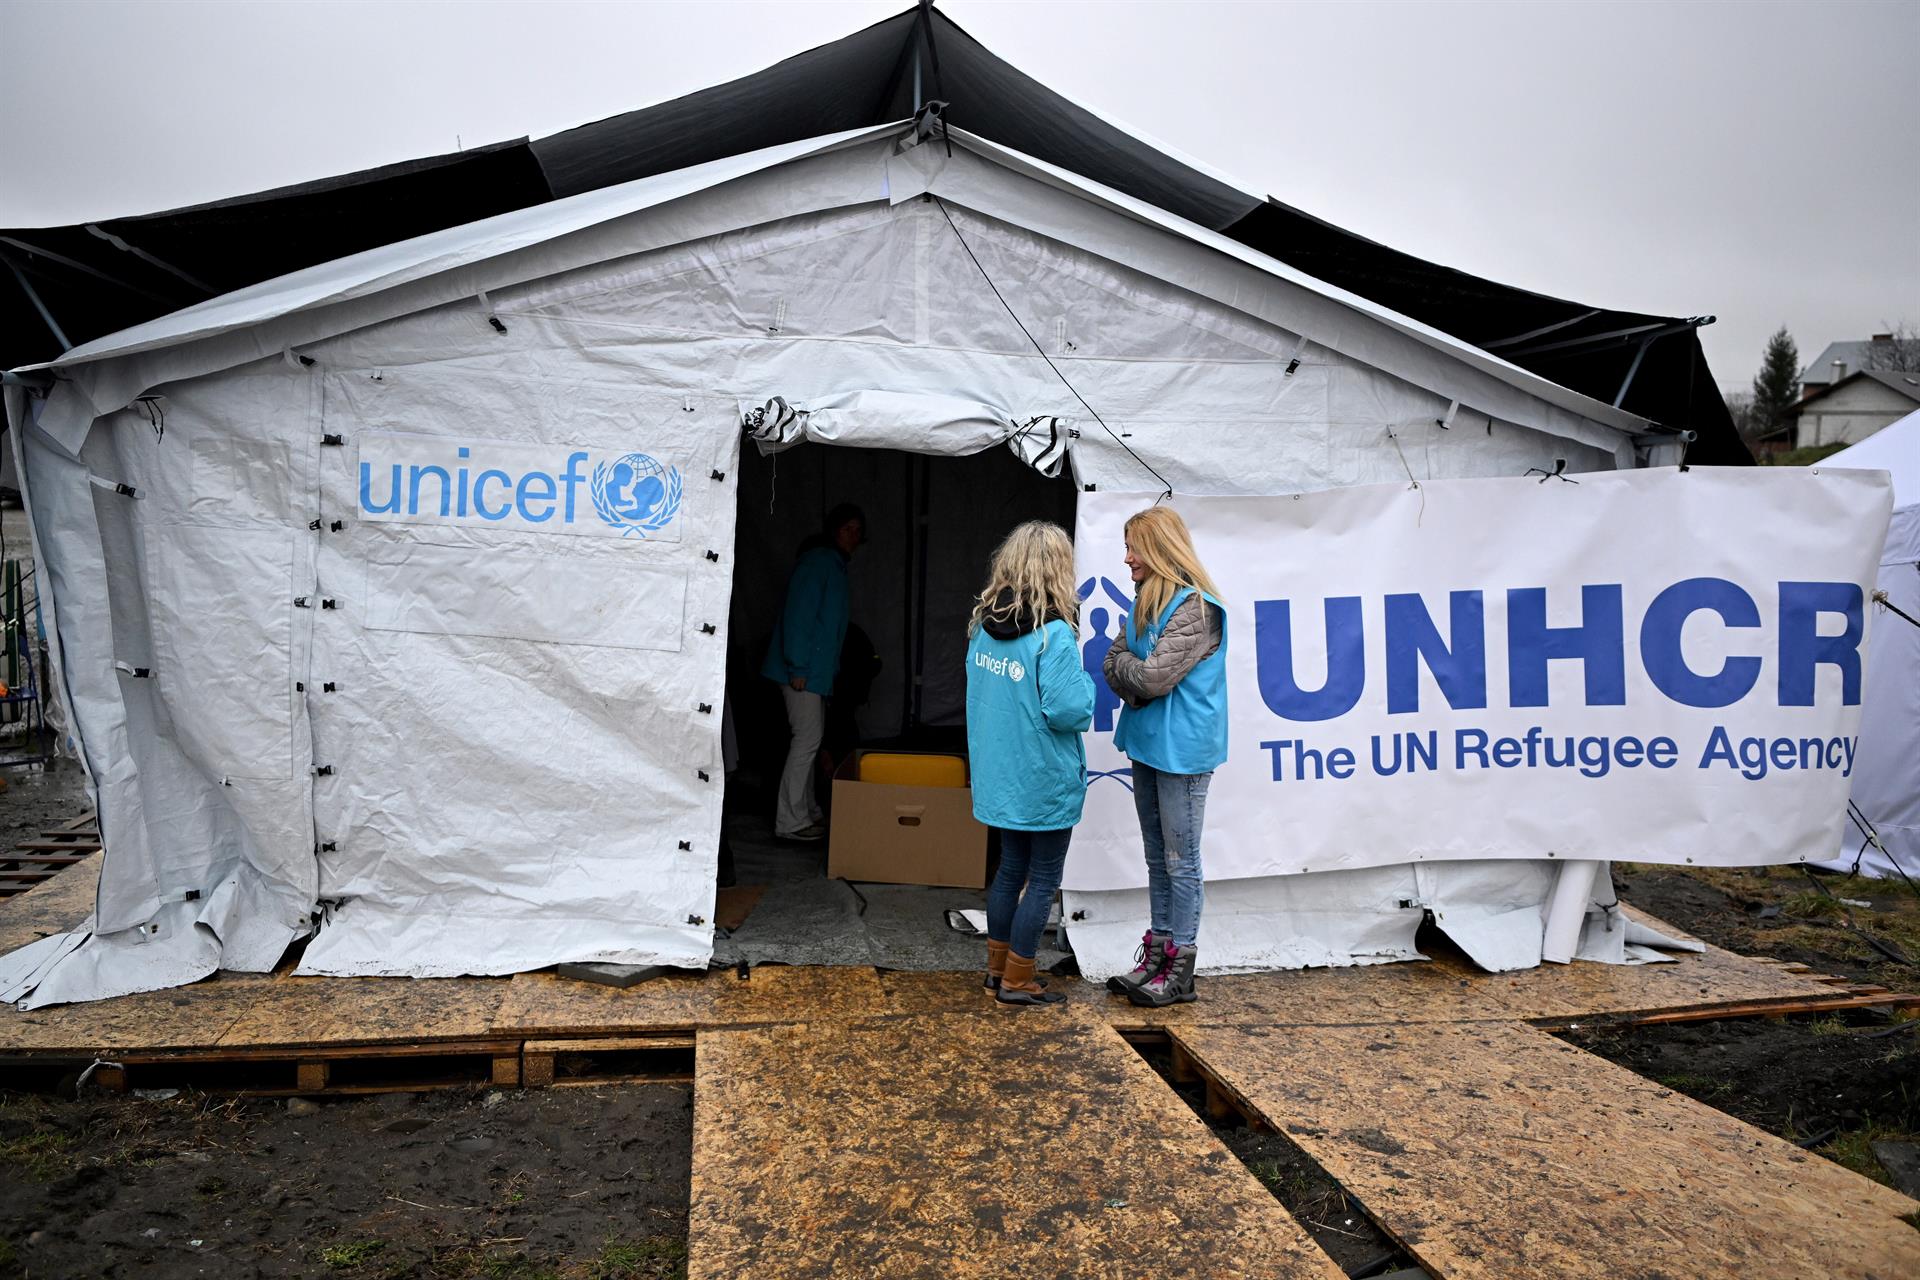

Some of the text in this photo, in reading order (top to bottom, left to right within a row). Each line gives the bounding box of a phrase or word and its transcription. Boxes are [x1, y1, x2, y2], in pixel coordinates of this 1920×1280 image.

[358, 446, 590, 525] unicef
[975, 651, 1008, 677] unicef
[1254, 576, 1864, 723] UNHCR
[1260, 725, 1859, 782] The UN Refugee Agency
